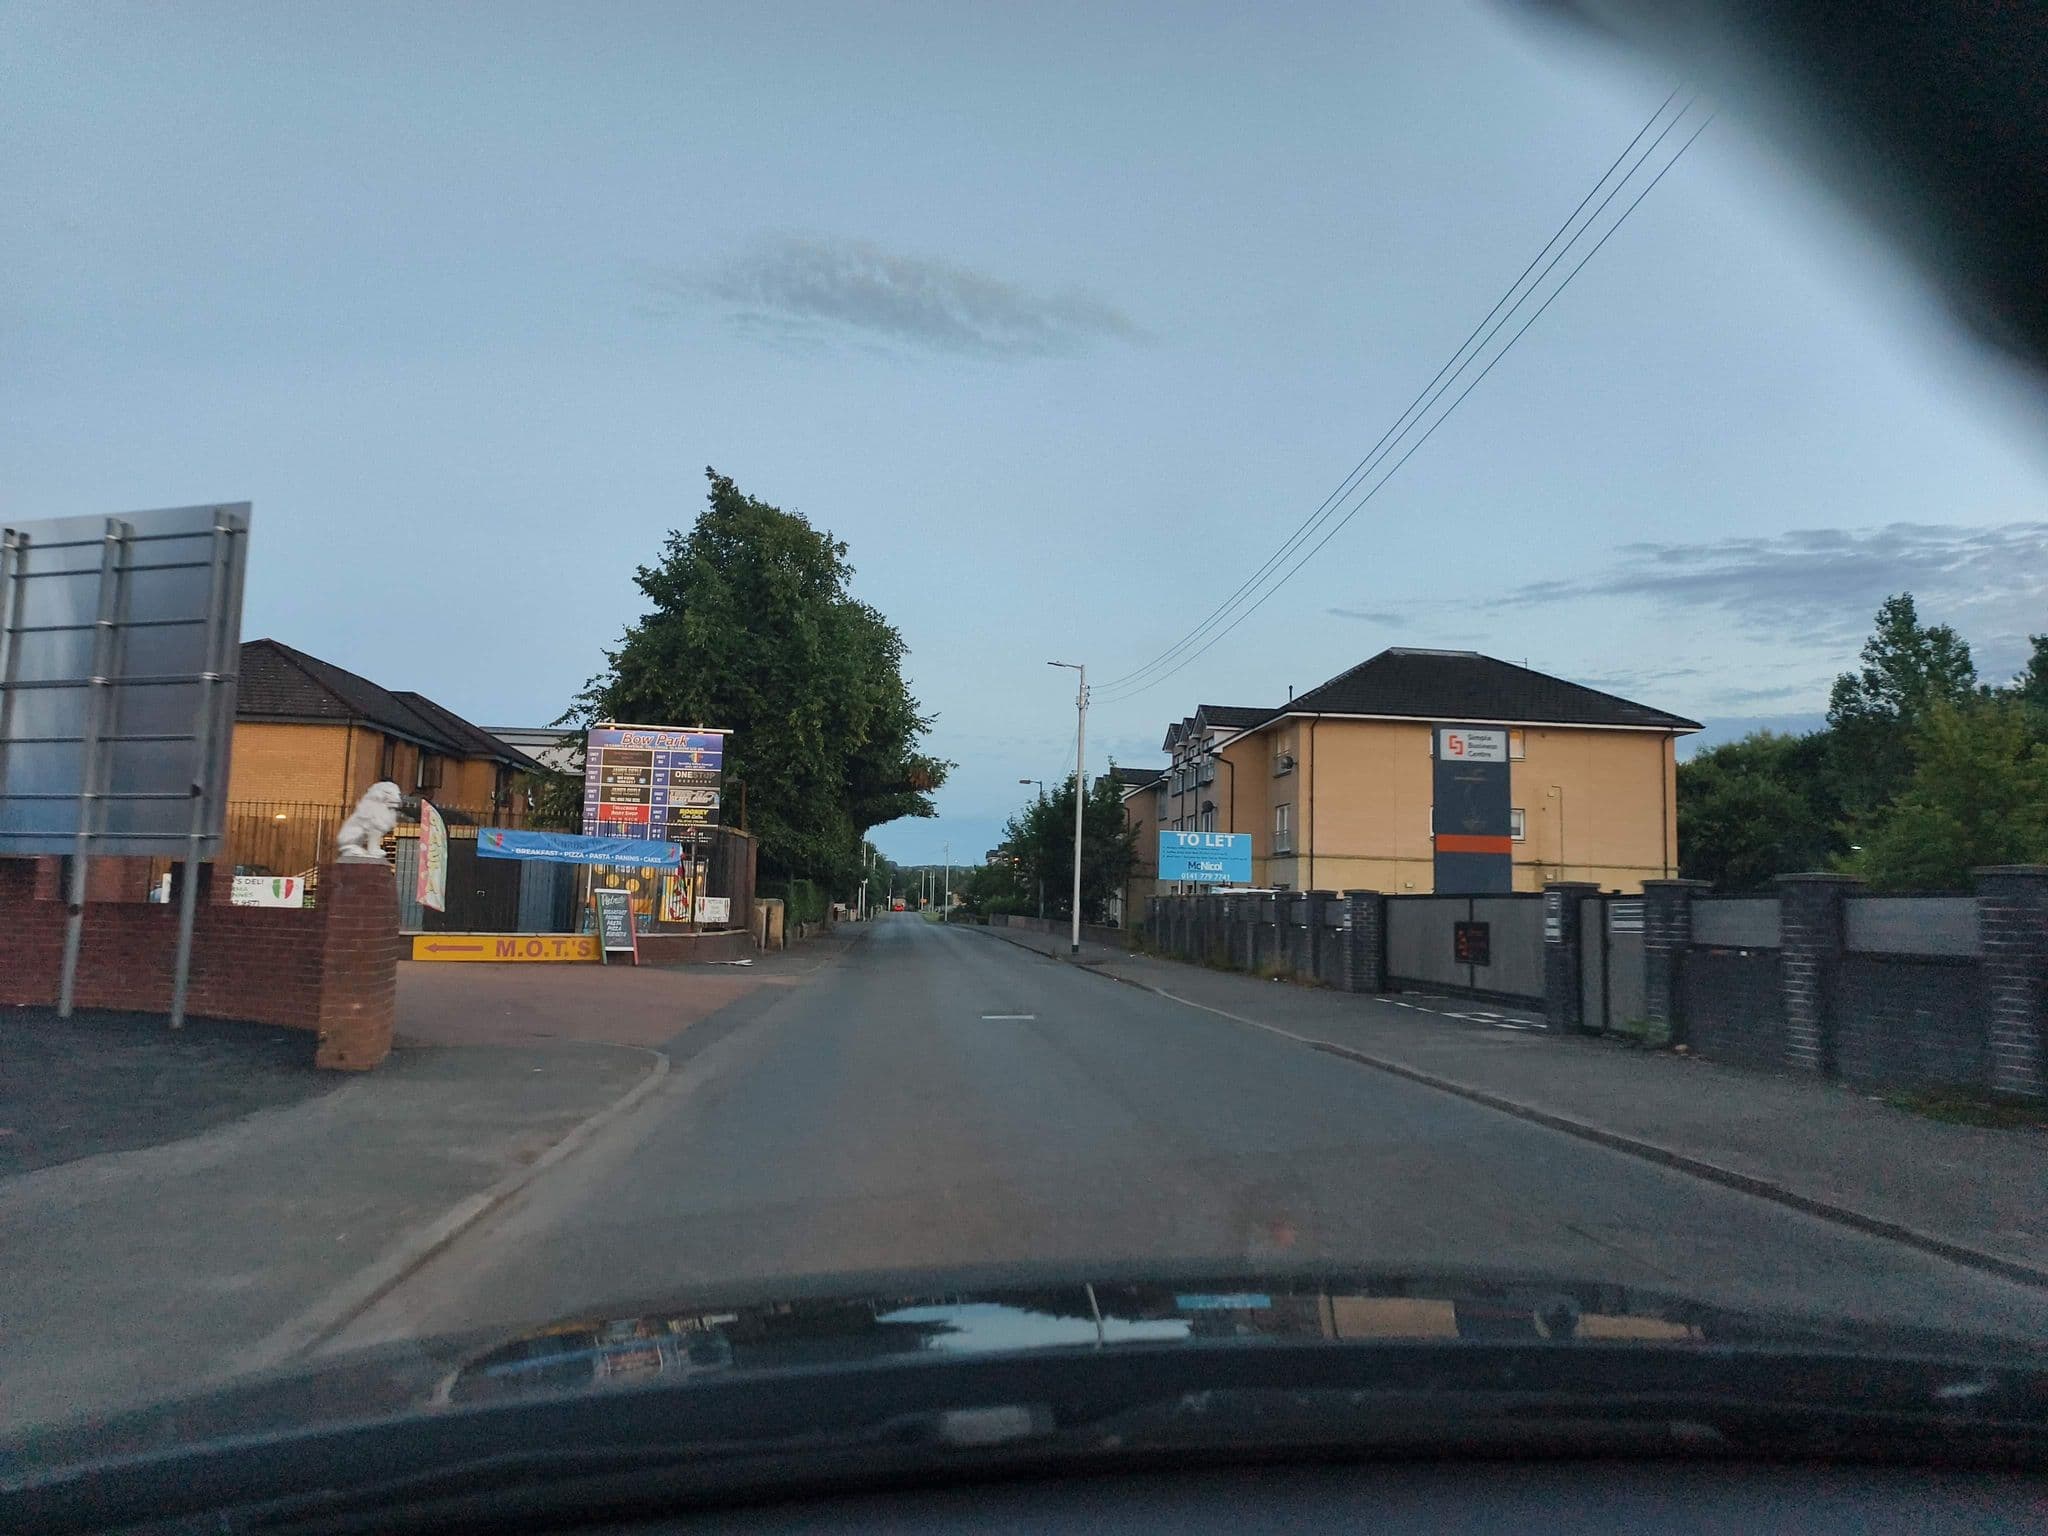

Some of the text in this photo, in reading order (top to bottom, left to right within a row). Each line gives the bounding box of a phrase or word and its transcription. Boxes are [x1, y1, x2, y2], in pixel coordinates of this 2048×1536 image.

[621, 733, 690, 747] Bow Park
[1468, 742, 1498, 750] Business
[1177, 833, 1235, 848] TO LET
[515, 848, 559, 857] BREAKFAST
[564, 851, 585, 859] PIZZA
[615, 854, 640, 862] PANINIS
[1187, 861, 1223, 871] McNicol
